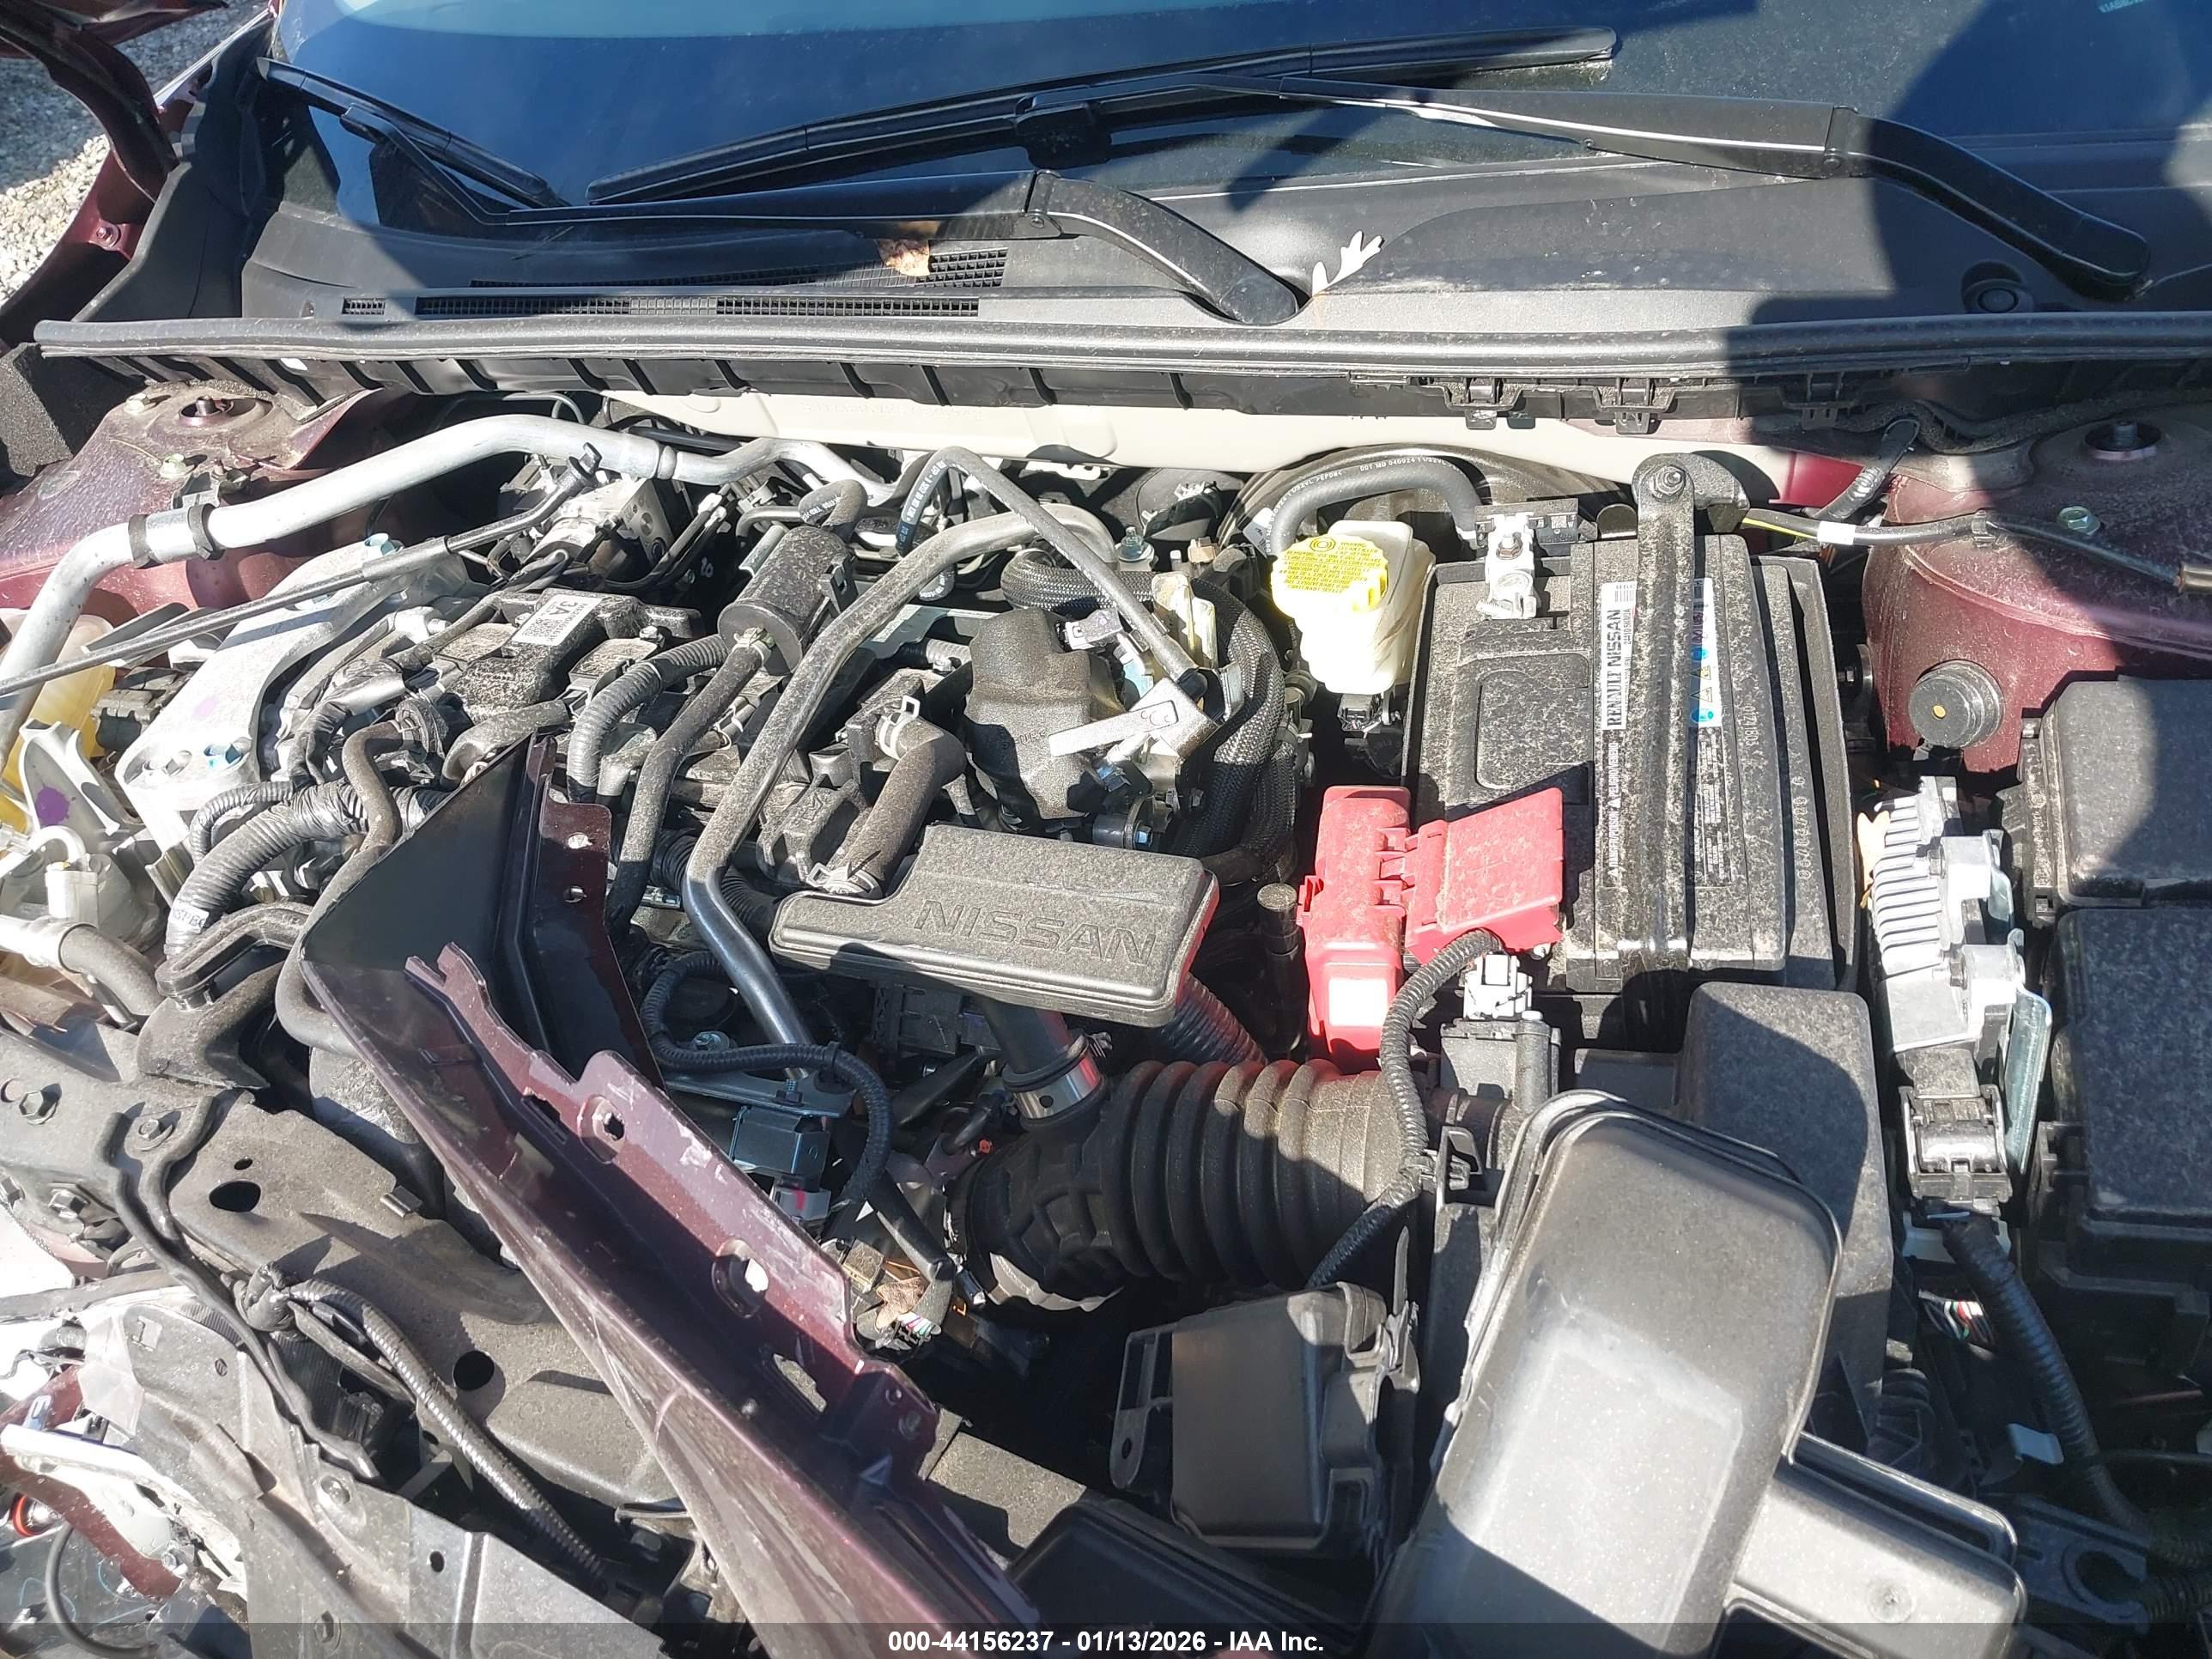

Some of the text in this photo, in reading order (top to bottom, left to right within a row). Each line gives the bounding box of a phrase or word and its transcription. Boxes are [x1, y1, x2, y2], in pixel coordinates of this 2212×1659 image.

[1607, 609, 1622, 726] RENAULT NISSAN
[914, 899, 1157, 967] NISSAN
